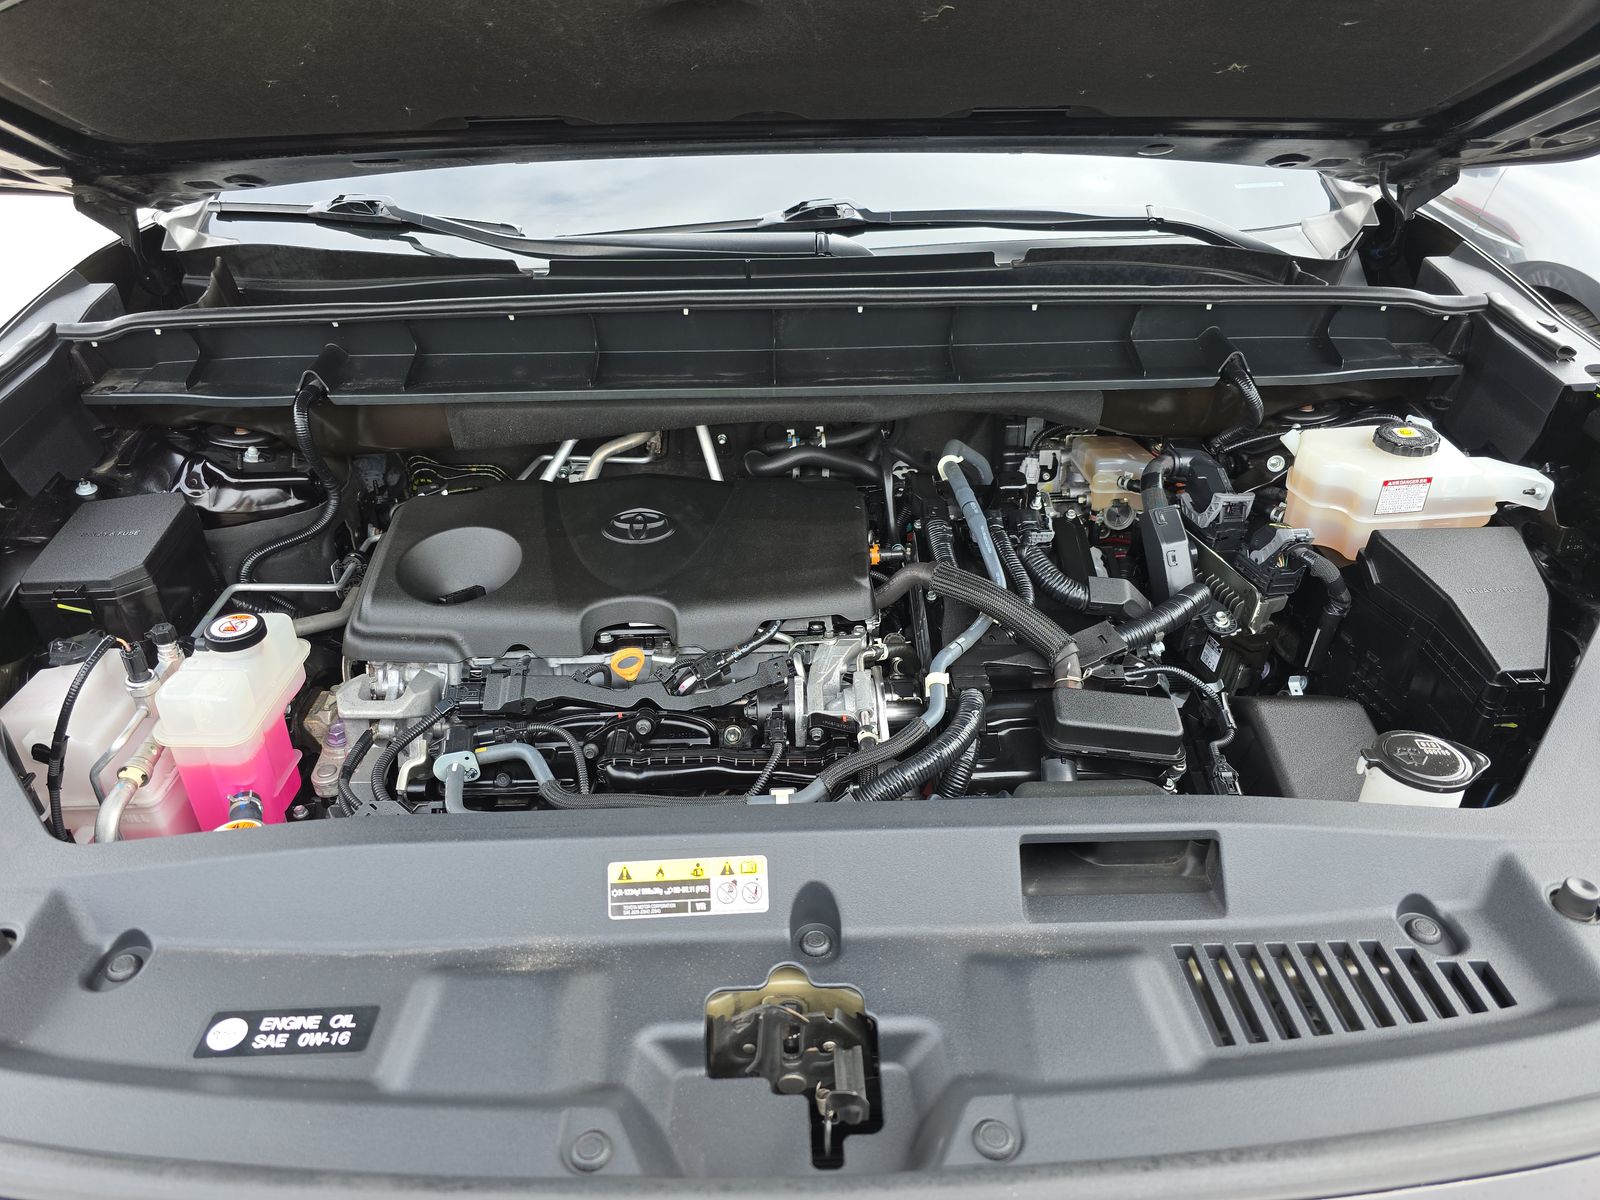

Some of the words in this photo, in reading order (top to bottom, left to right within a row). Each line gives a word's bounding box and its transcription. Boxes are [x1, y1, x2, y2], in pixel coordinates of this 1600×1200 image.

[259, 1015, 323, 1031] ENGINE
[329, 1014, 356, 1029] OIL
[252, 1034, 290, 1049] SAE
[297, 1031, 351, 1047] 0W-16
